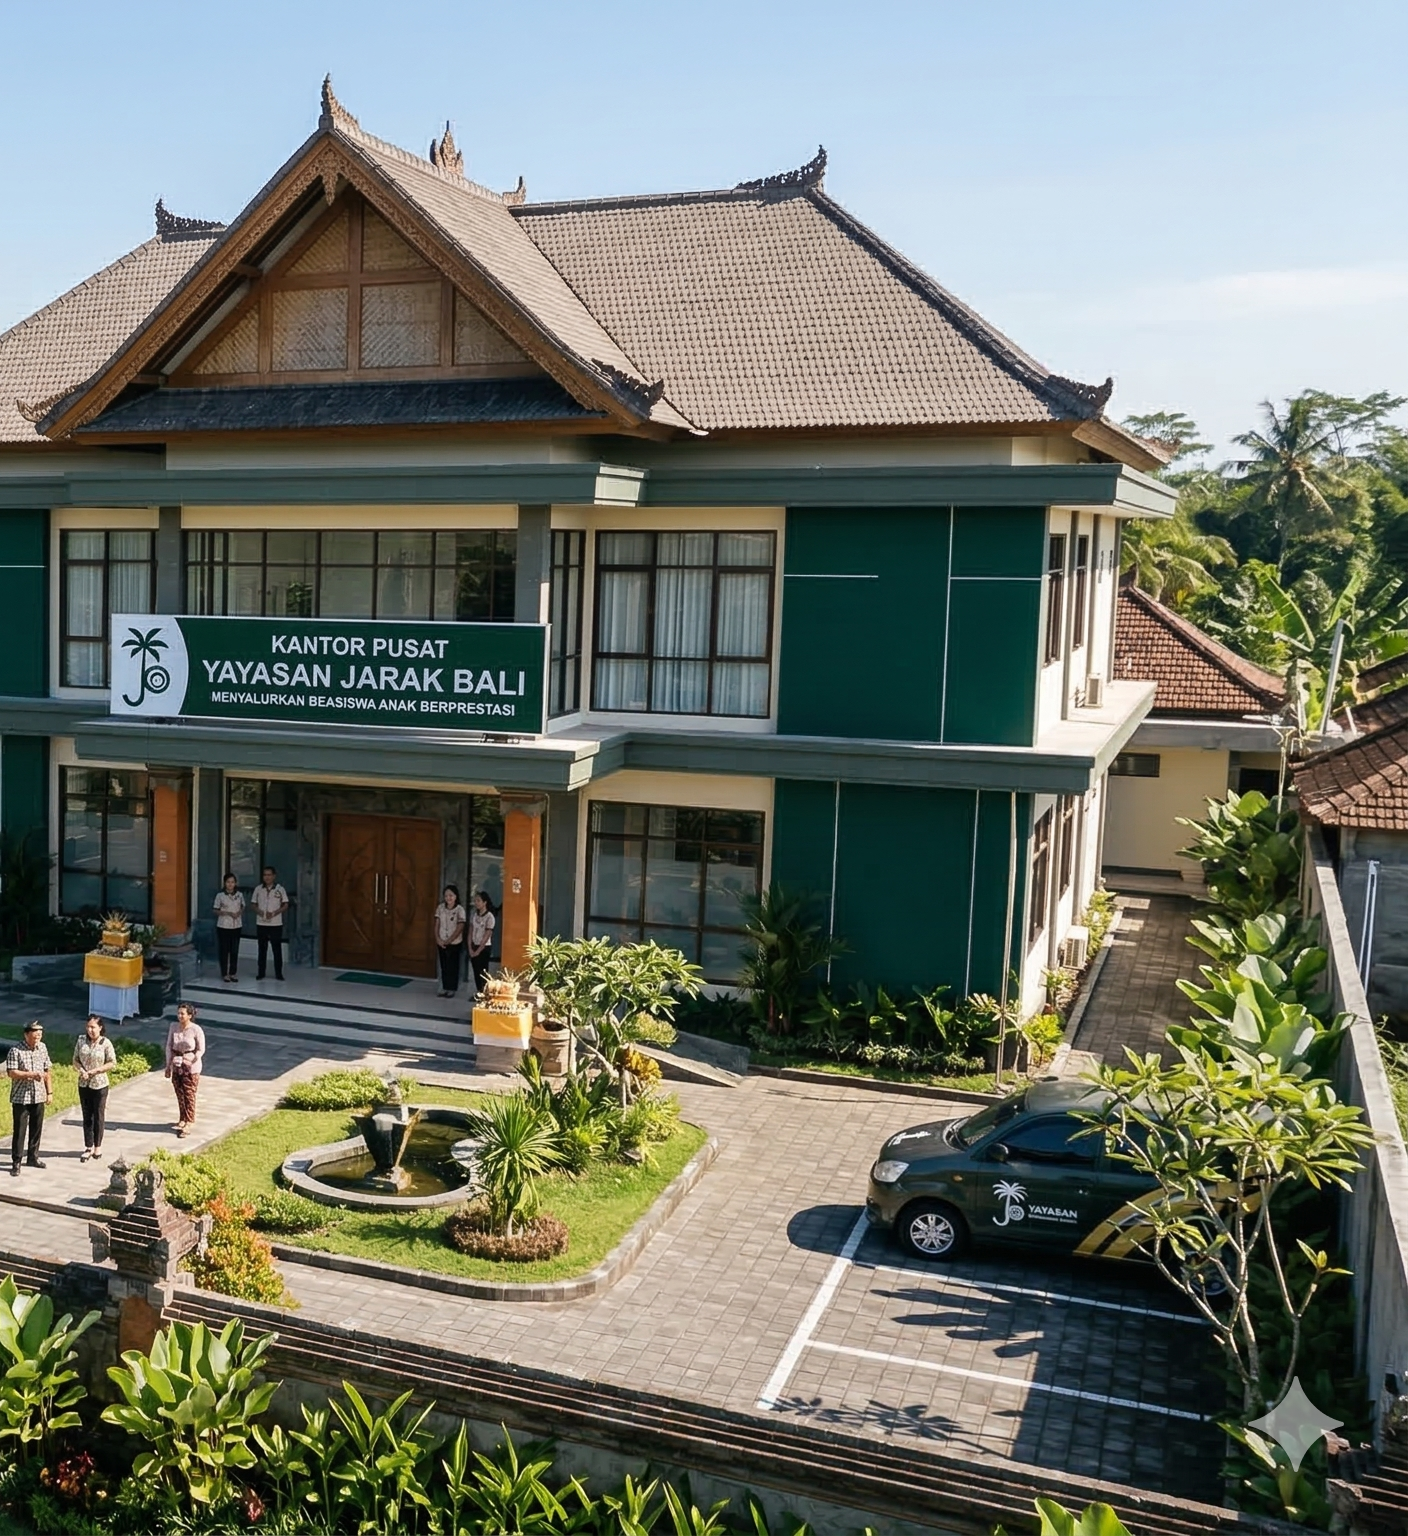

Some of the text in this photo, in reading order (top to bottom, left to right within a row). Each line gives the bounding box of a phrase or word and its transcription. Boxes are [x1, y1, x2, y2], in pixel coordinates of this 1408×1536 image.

[271, 635, 449, 659] KANTOR PUSAT
[202, 660, 525, 696] YAYASAN JARAK BALI
[211, 691, 515, 717] MENYALURKAN BEASISWA ANAK BERPRESTASI
